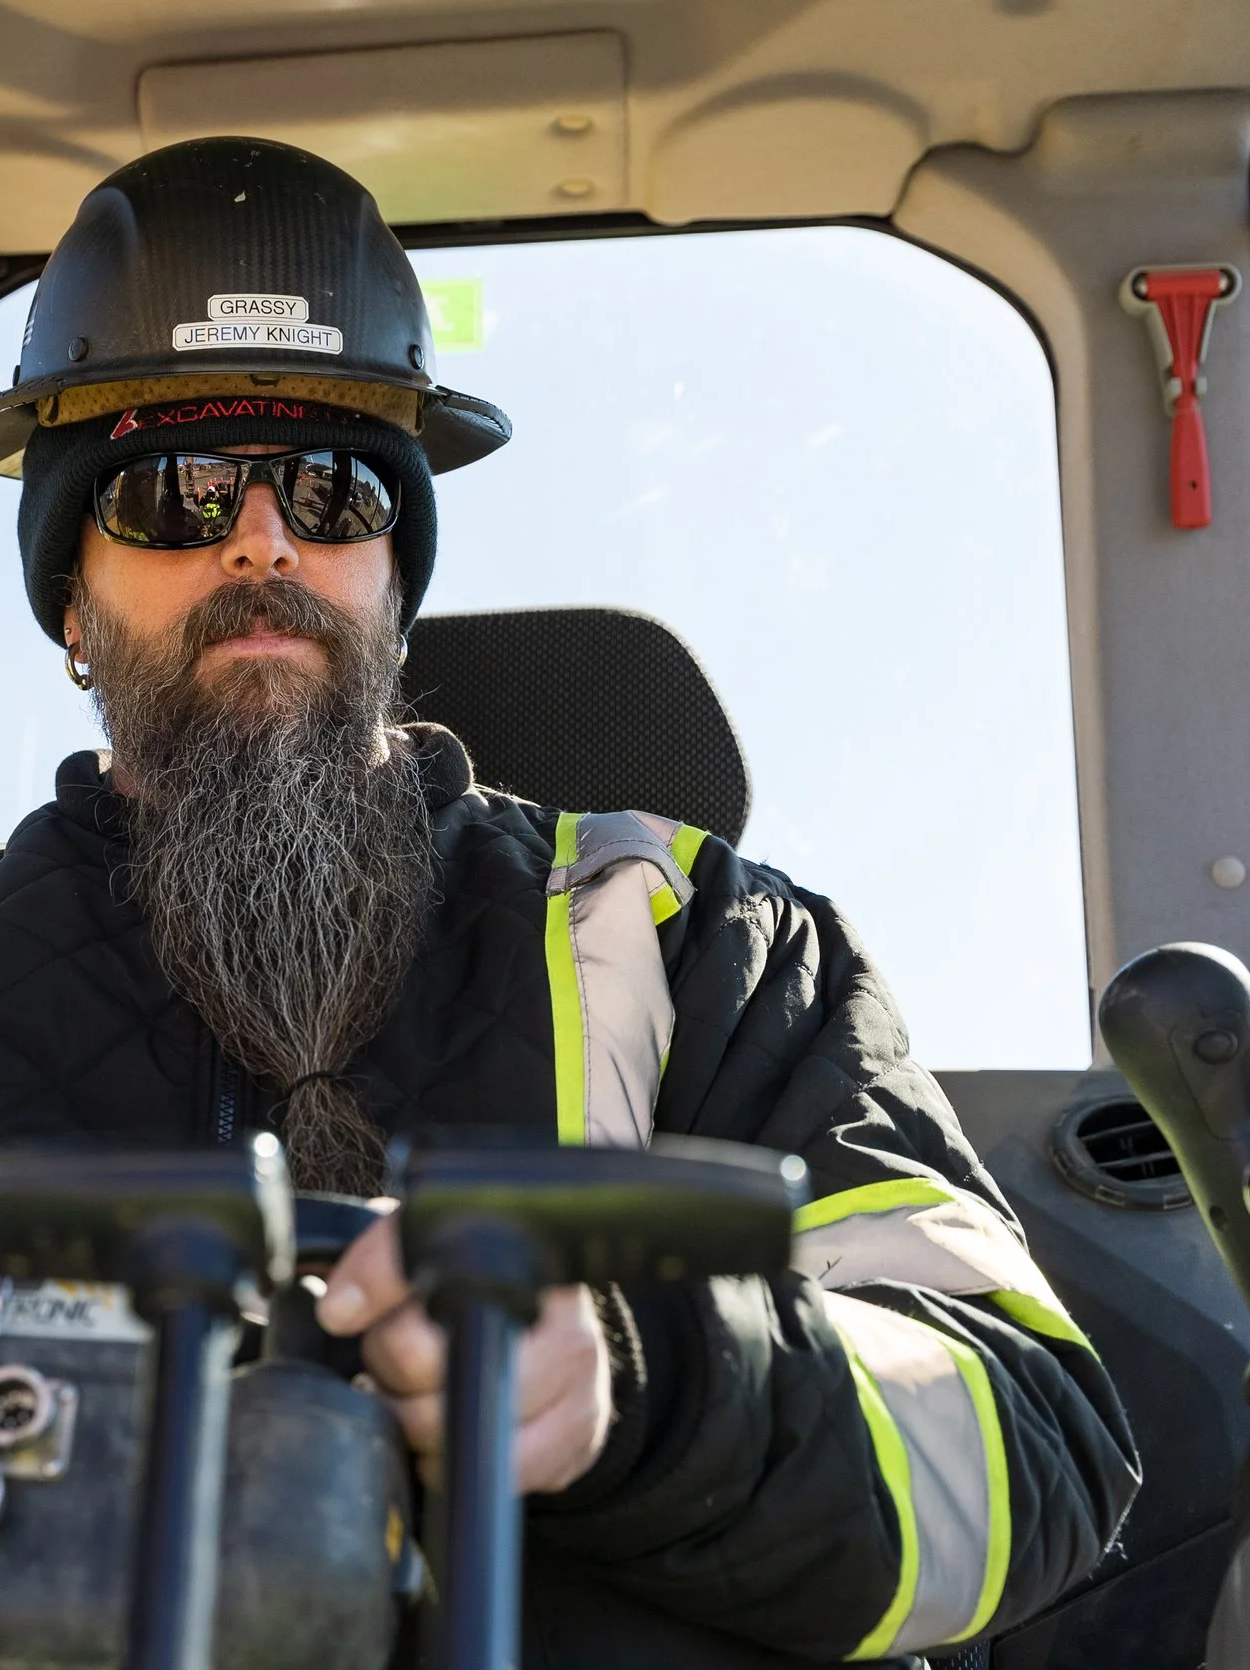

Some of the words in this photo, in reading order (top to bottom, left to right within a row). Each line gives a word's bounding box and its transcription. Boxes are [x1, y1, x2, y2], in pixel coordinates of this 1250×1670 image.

[220, 299, 297, 316] GRASSY
[184, 326, 261, 344] JEREMY
[266, 326, 333, 347] KNIGHT
